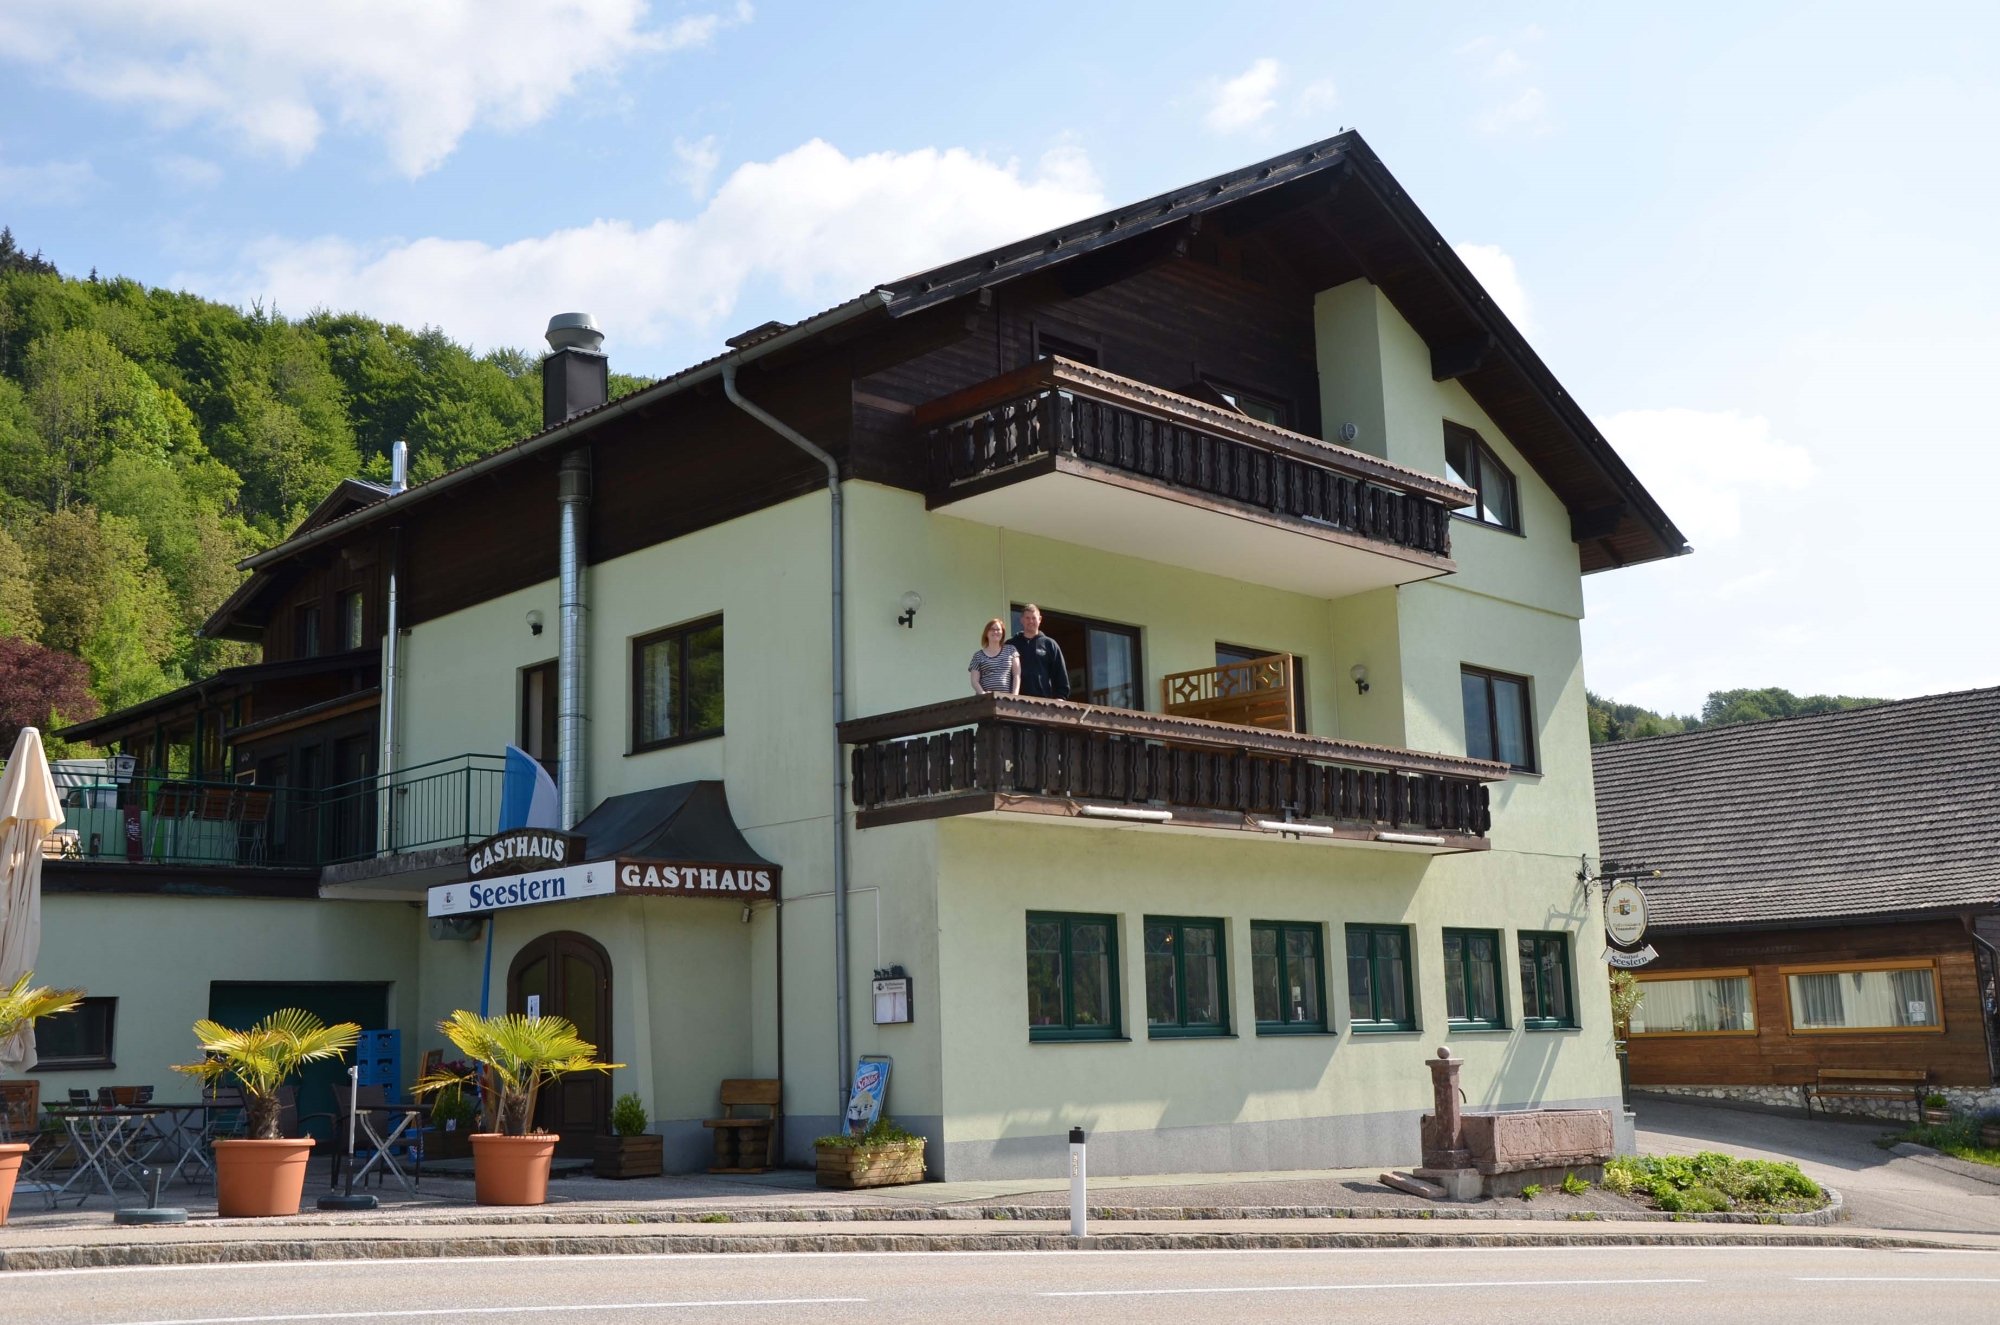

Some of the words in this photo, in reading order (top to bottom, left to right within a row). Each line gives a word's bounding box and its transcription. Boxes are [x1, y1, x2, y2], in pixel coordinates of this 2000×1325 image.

[470, 836, 565, 874] GASTHAUS
[470, 877, 566, 909] Seestern
[621, 865, 771, 892] GASTHAUS
[1611, 955, 1647, 966] Seestern
